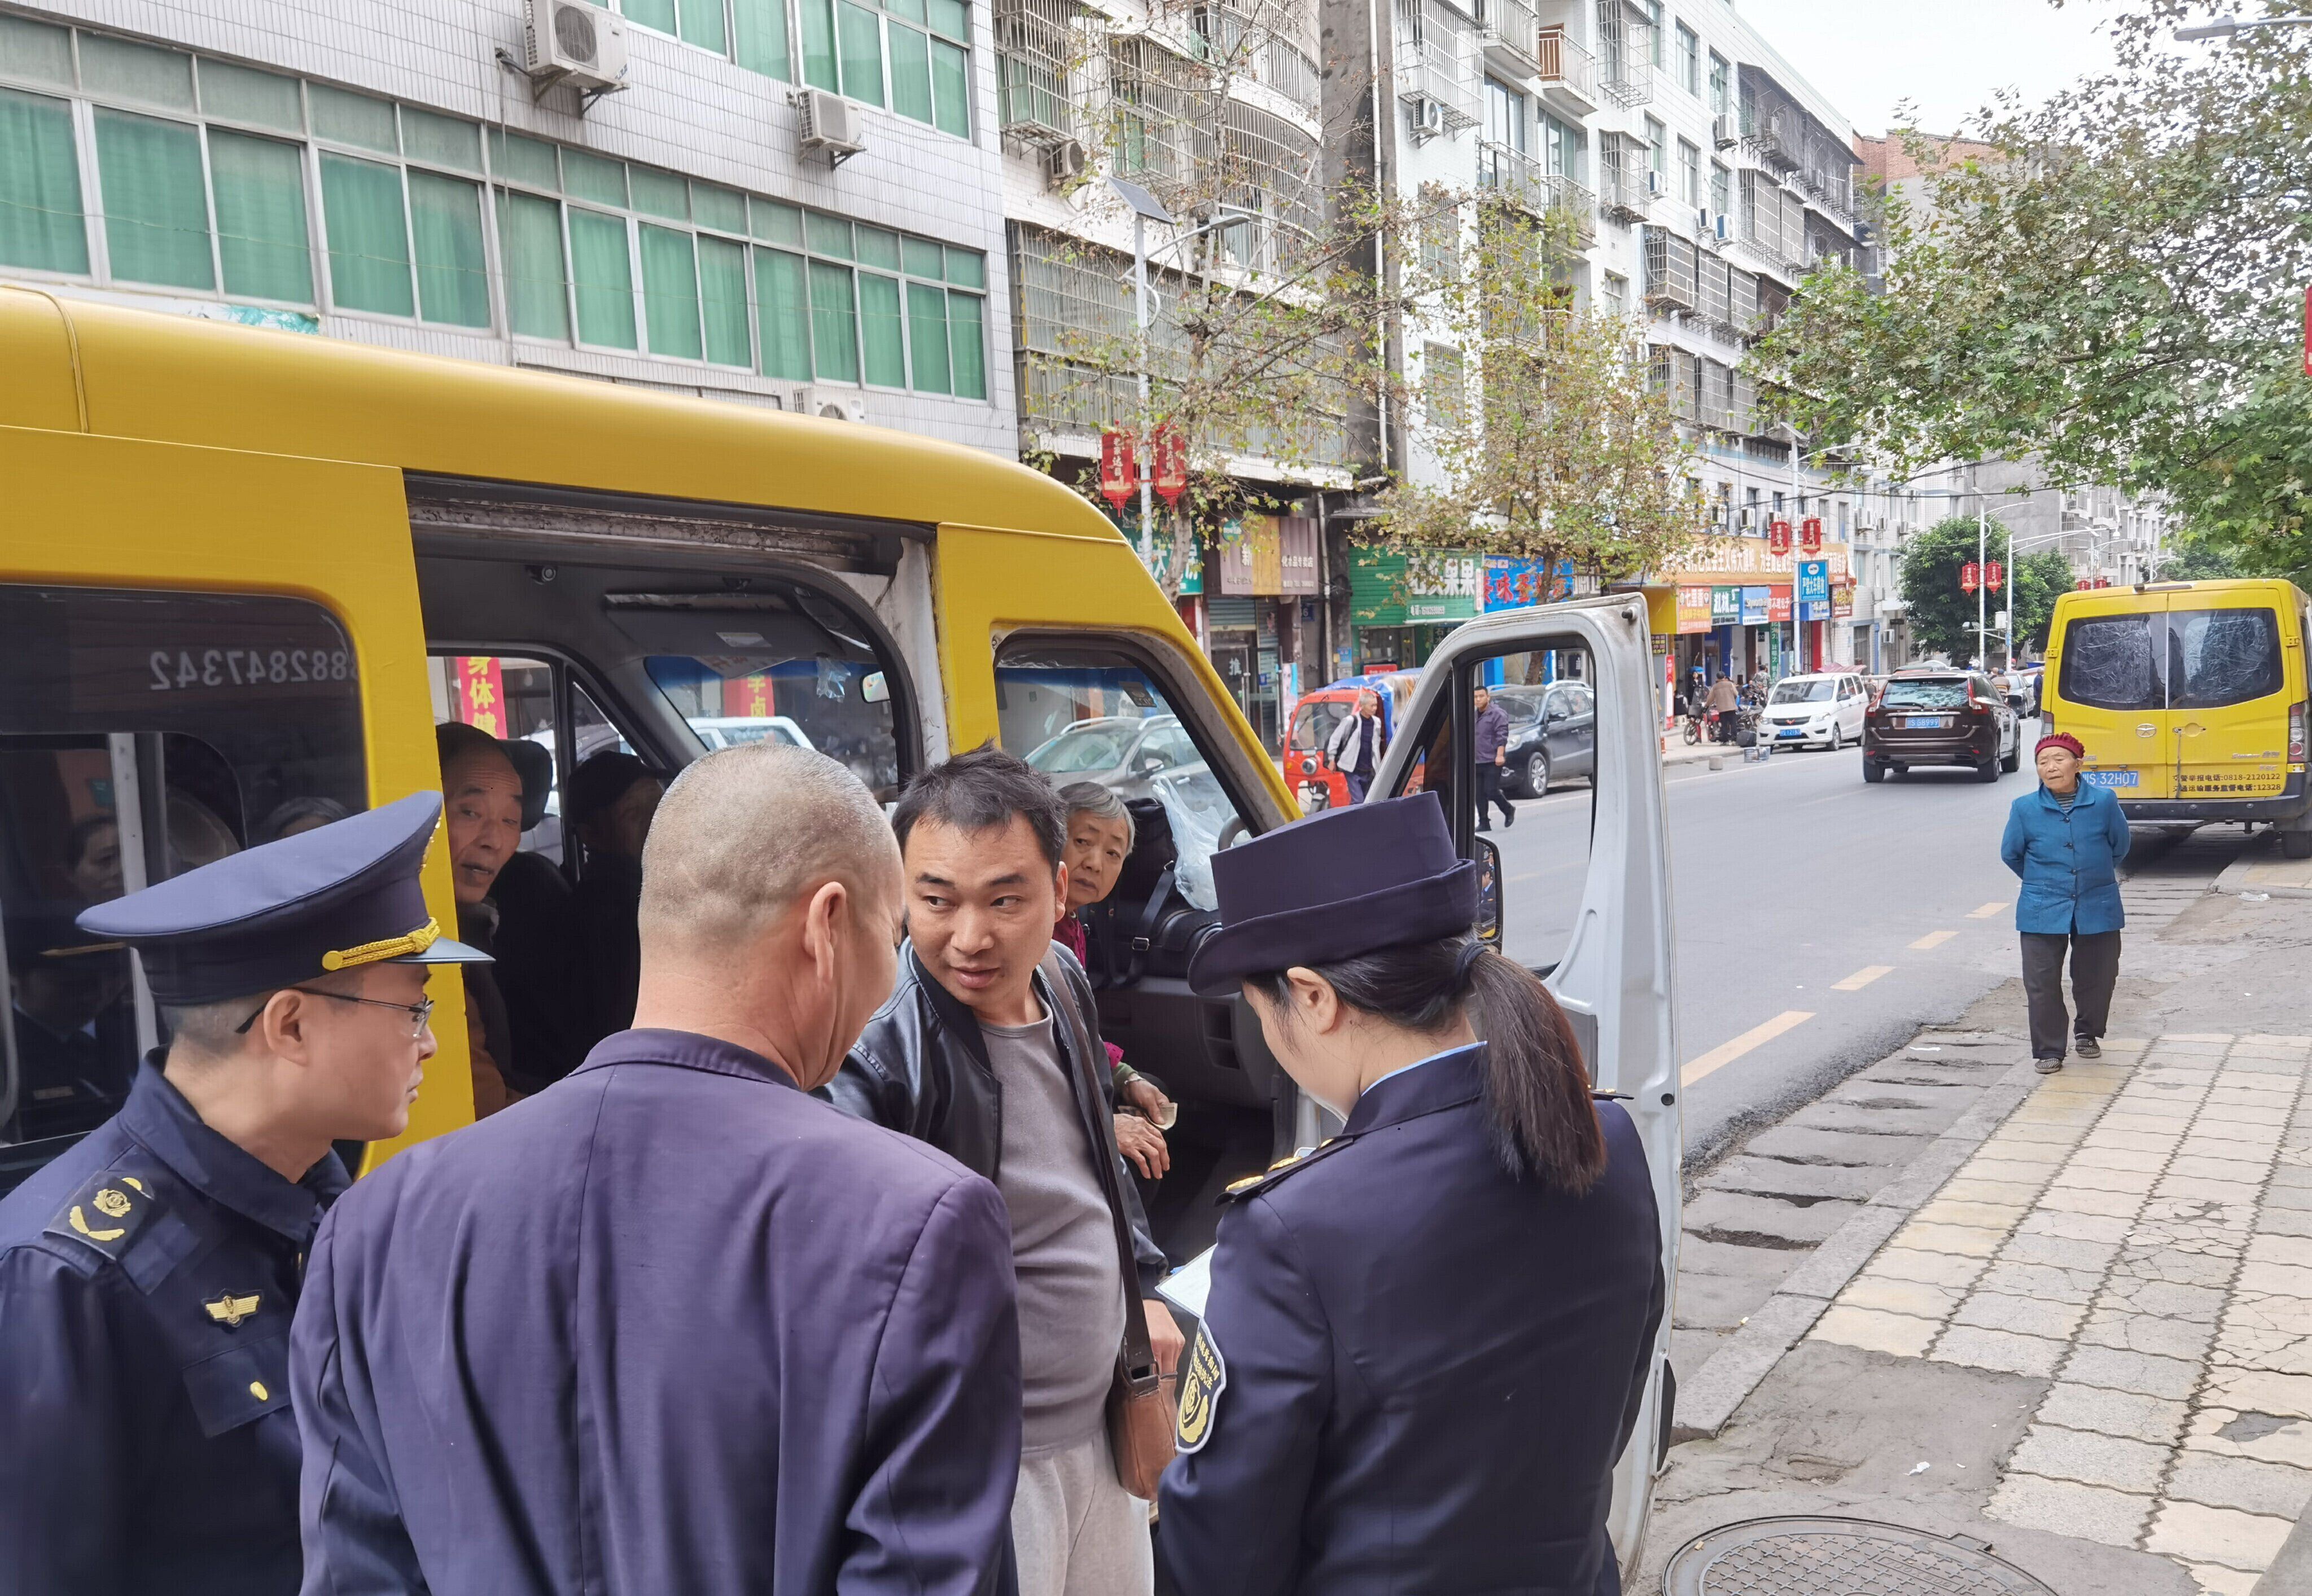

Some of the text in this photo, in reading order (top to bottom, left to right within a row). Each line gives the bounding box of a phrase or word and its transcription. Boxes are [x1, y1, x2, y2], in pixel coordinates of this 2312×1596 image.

[1684, 587, 1704, 607] 七里香
[1229, 657, 1242, 676] 推
